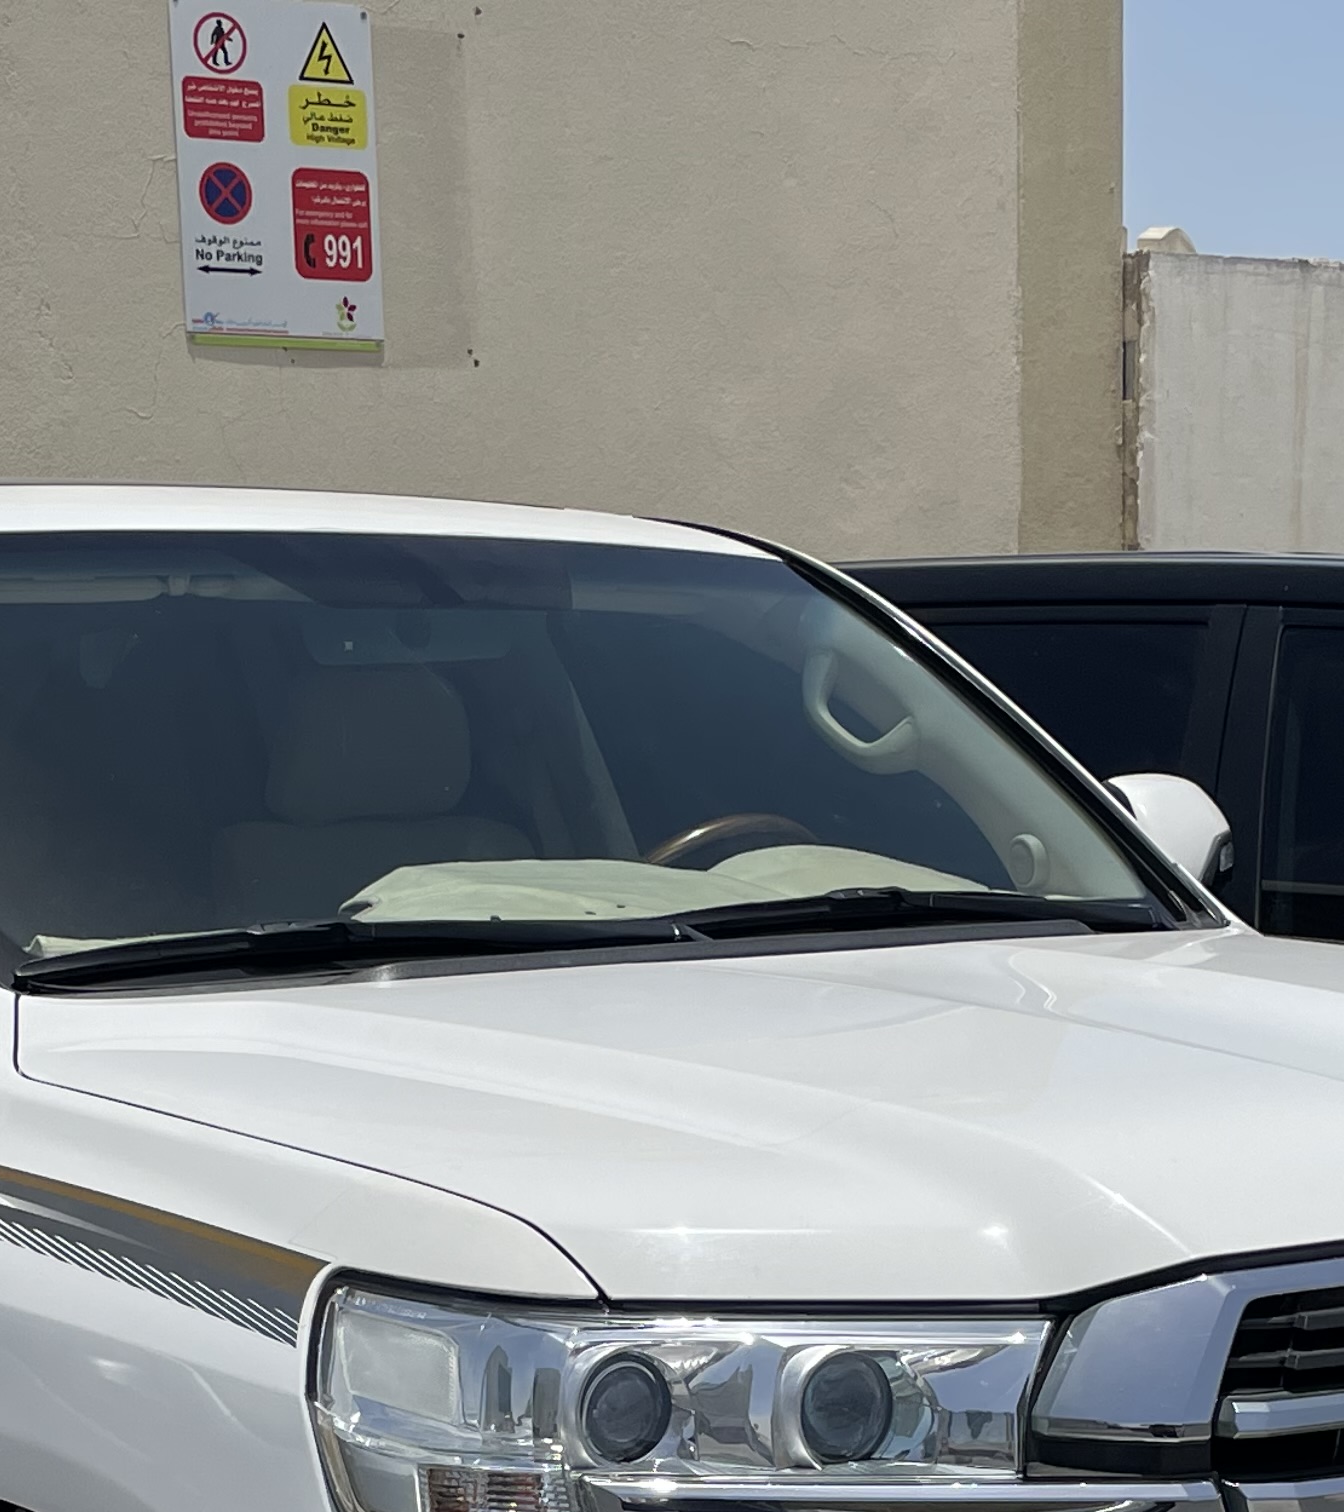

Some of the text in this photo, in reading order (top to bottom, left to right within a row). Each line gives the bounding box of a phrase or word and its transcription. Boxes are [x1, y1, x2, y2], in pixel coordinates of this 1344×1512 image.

[298, 91, 356, 110] خطر
[311, 122, 350, 135] Danger
[195, 248, 263, 266] No Parking
[324, 234, 363, 269] 991
